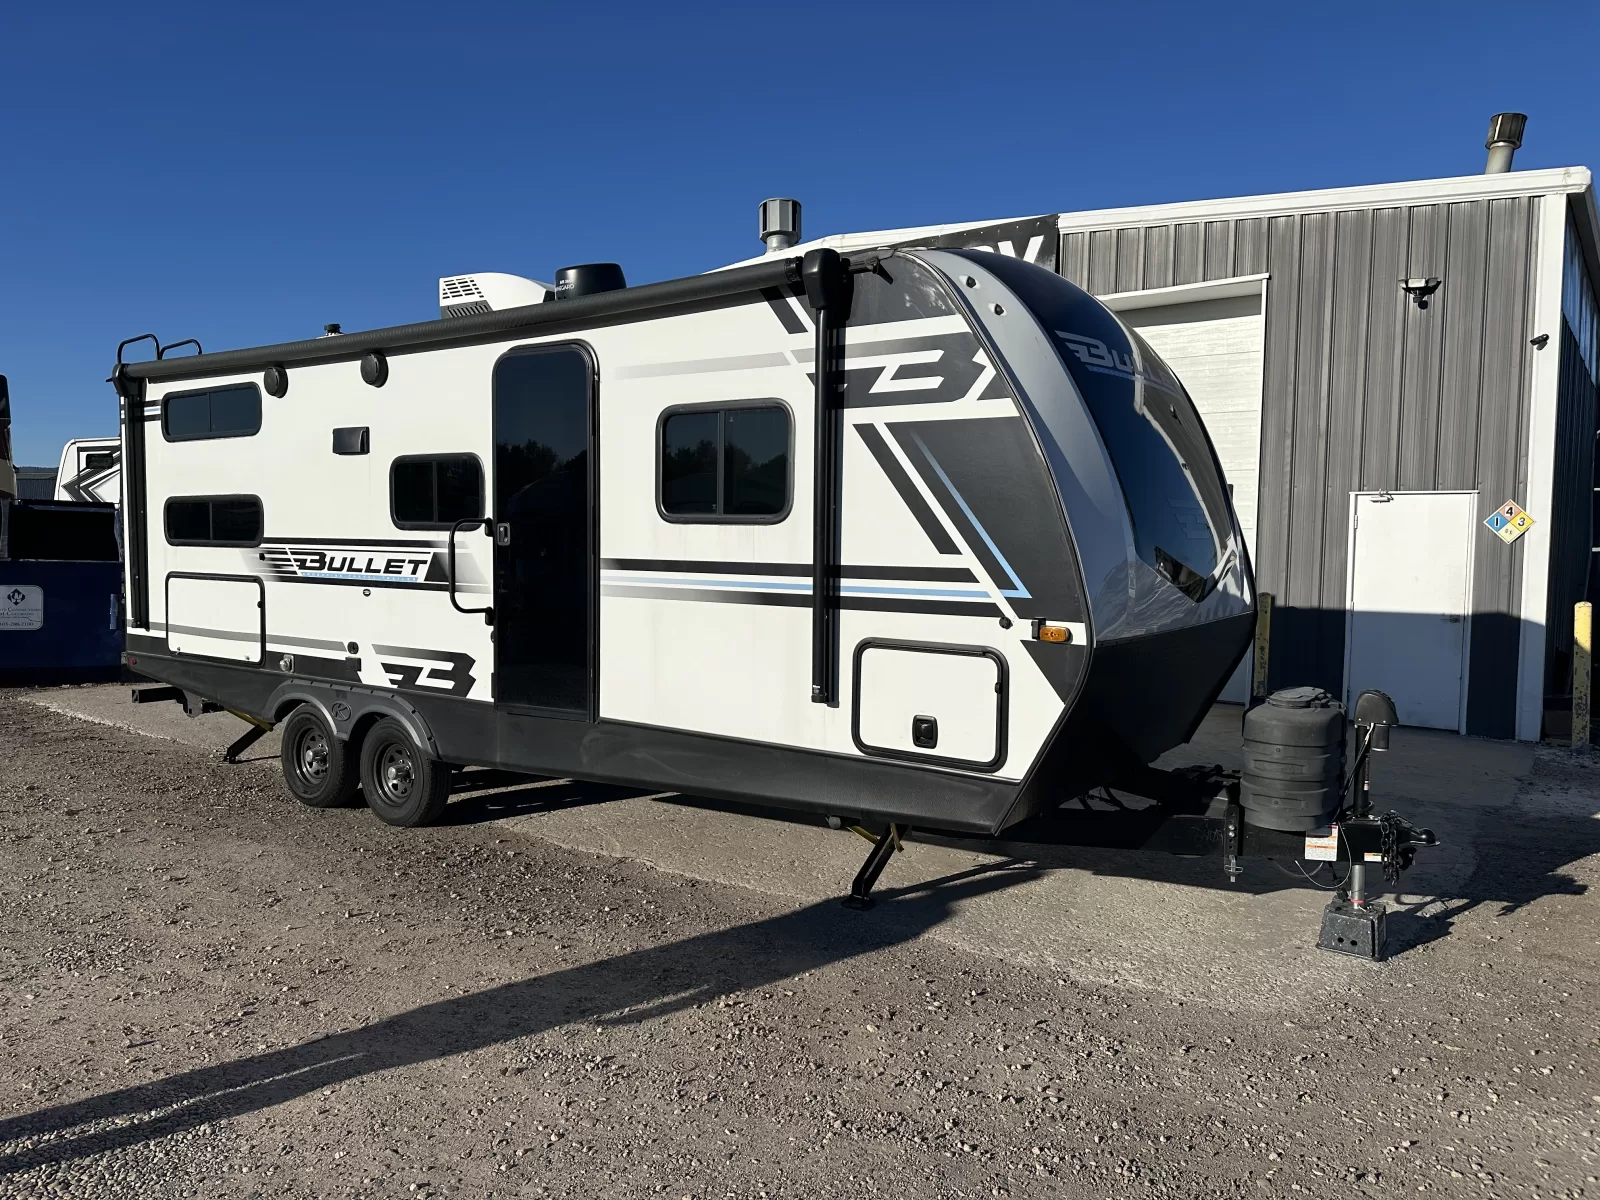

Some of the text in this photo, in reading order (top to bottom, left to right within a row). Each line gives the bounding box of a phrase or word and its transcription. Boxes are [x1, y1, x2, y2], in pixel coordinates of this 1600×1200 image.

[1505, 506, 1514, 516] 4
[1518, 517, 1526, 527] 3
[294, 551, 429, 576] BULLET
